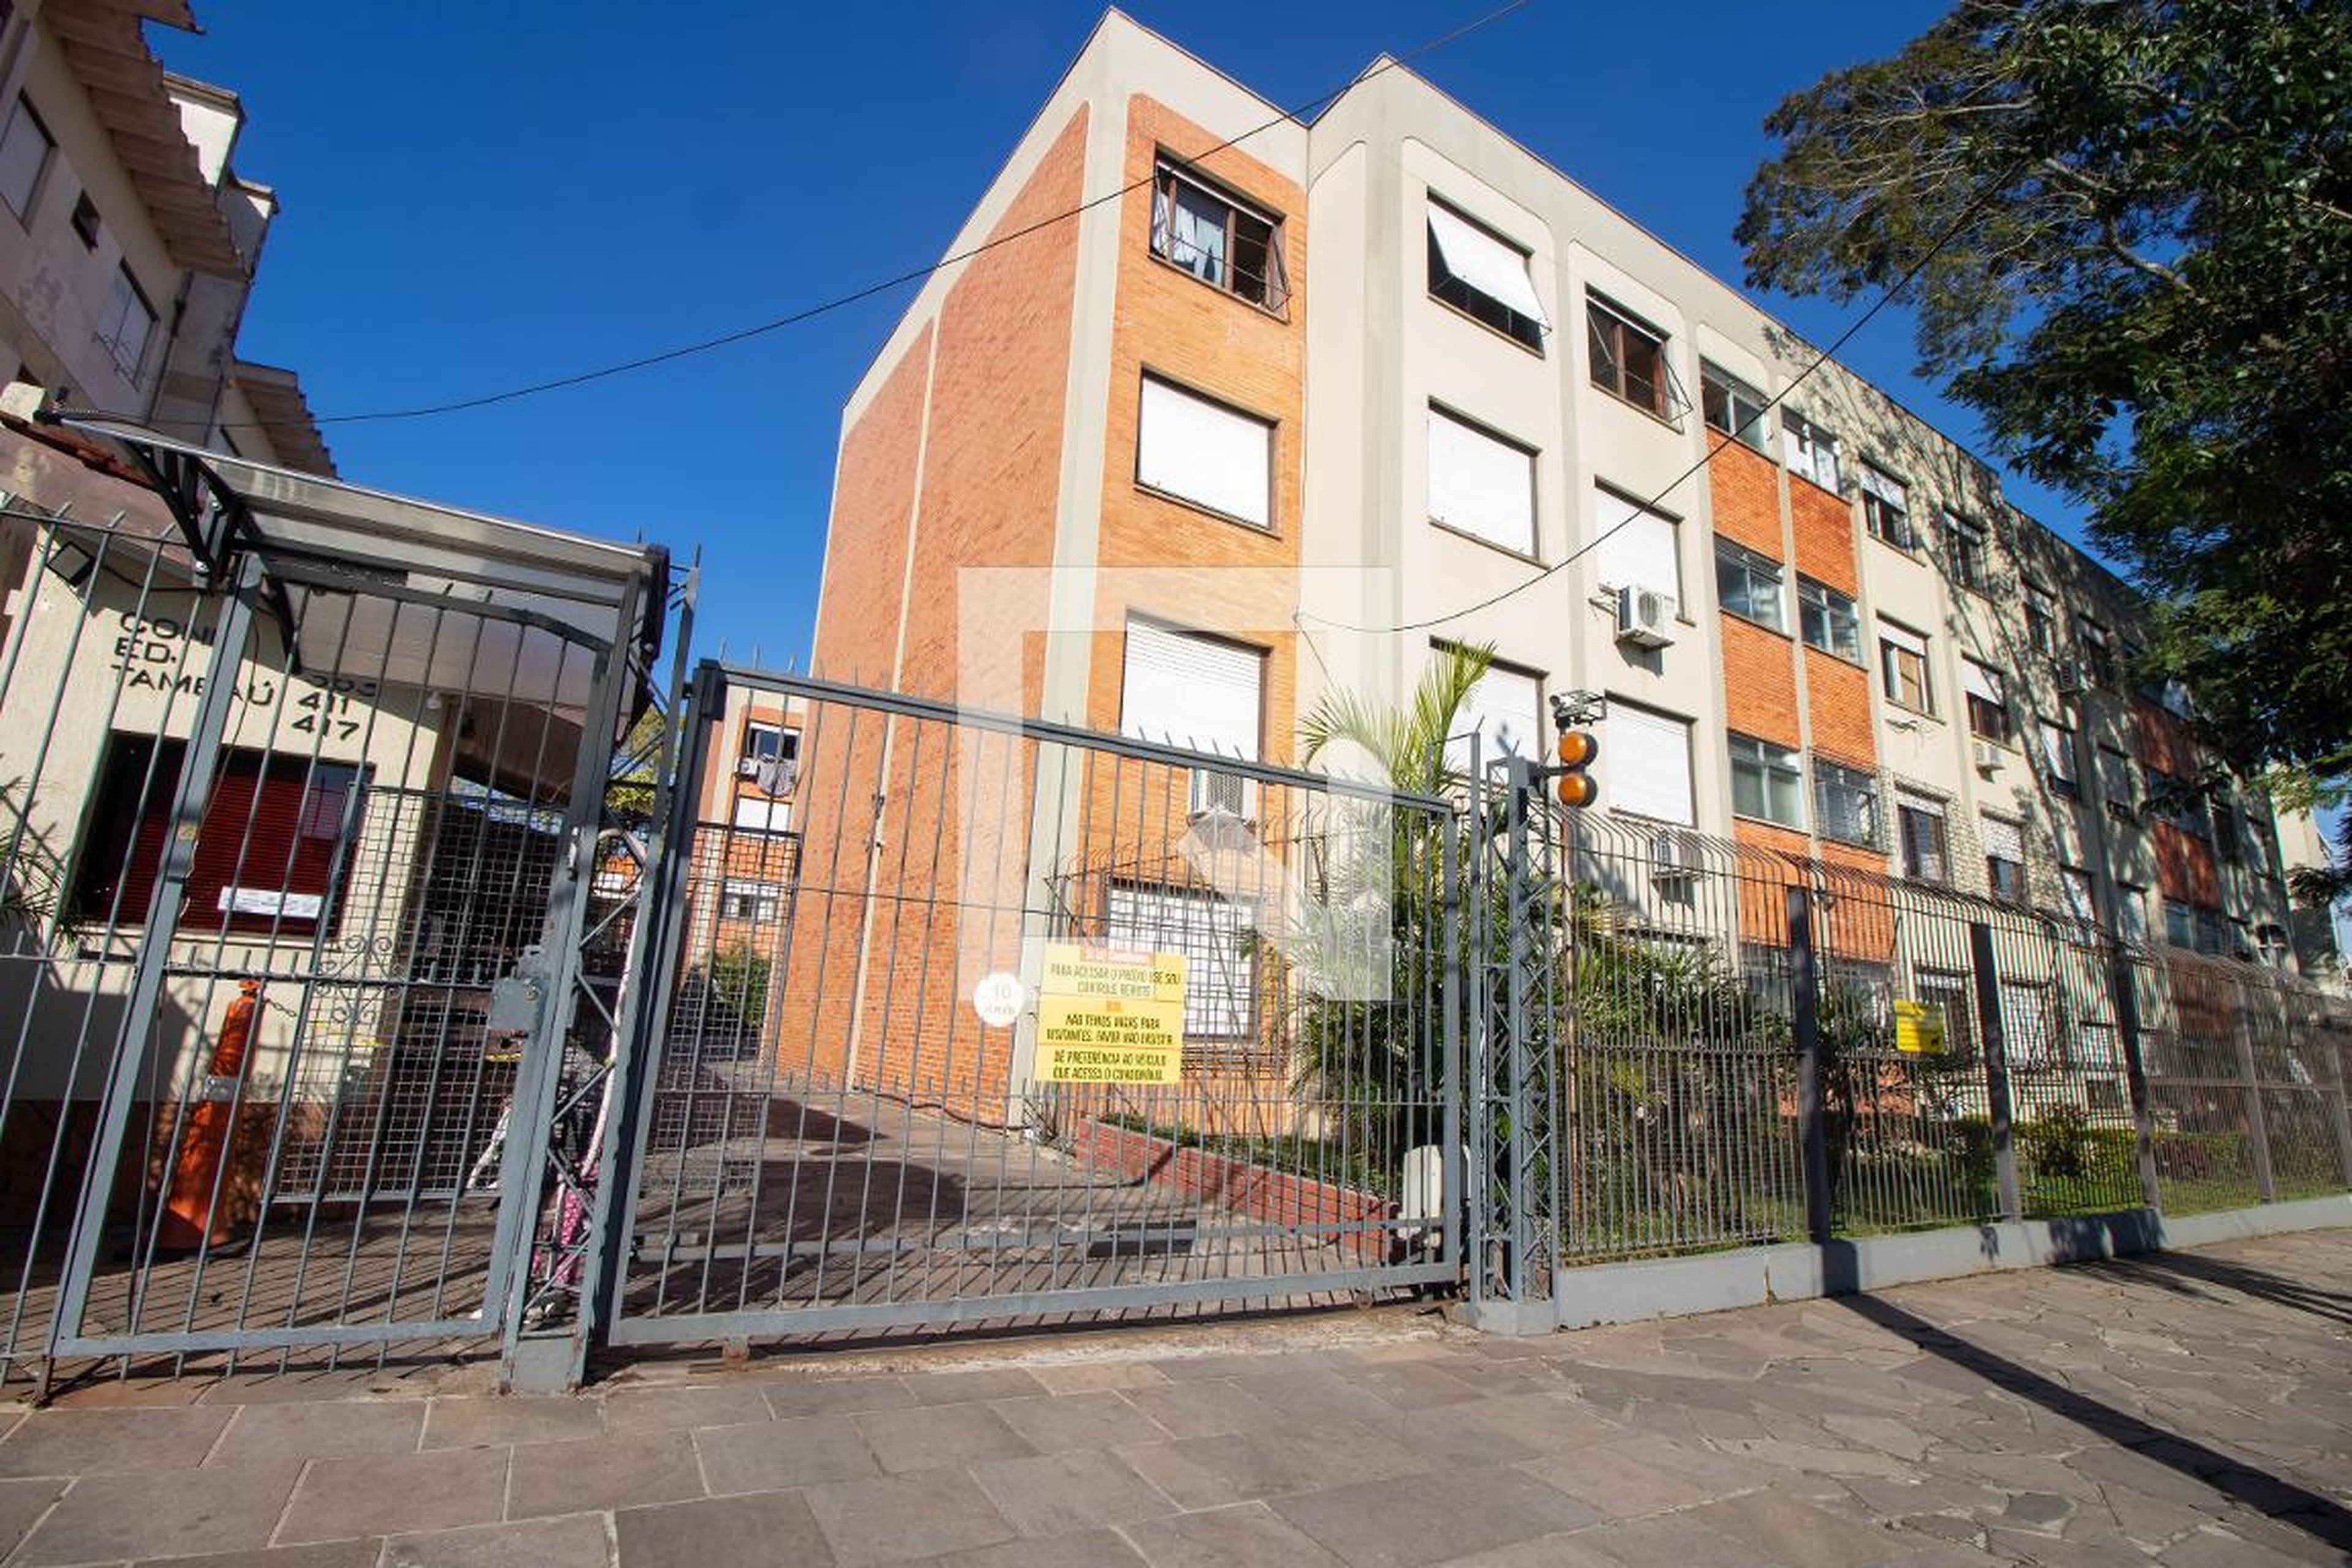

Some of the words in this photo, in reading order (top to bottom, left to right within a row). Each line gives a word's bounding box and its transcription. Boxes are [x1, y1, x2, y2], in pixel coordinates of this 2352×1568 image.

[120, 612, 216, 646] CON
[114, 637, 176, 663] ED.
[296, 691, 349, 715] 411
[292, 714, 360, 741] 417
[995, 983, 1012, 999] 10
